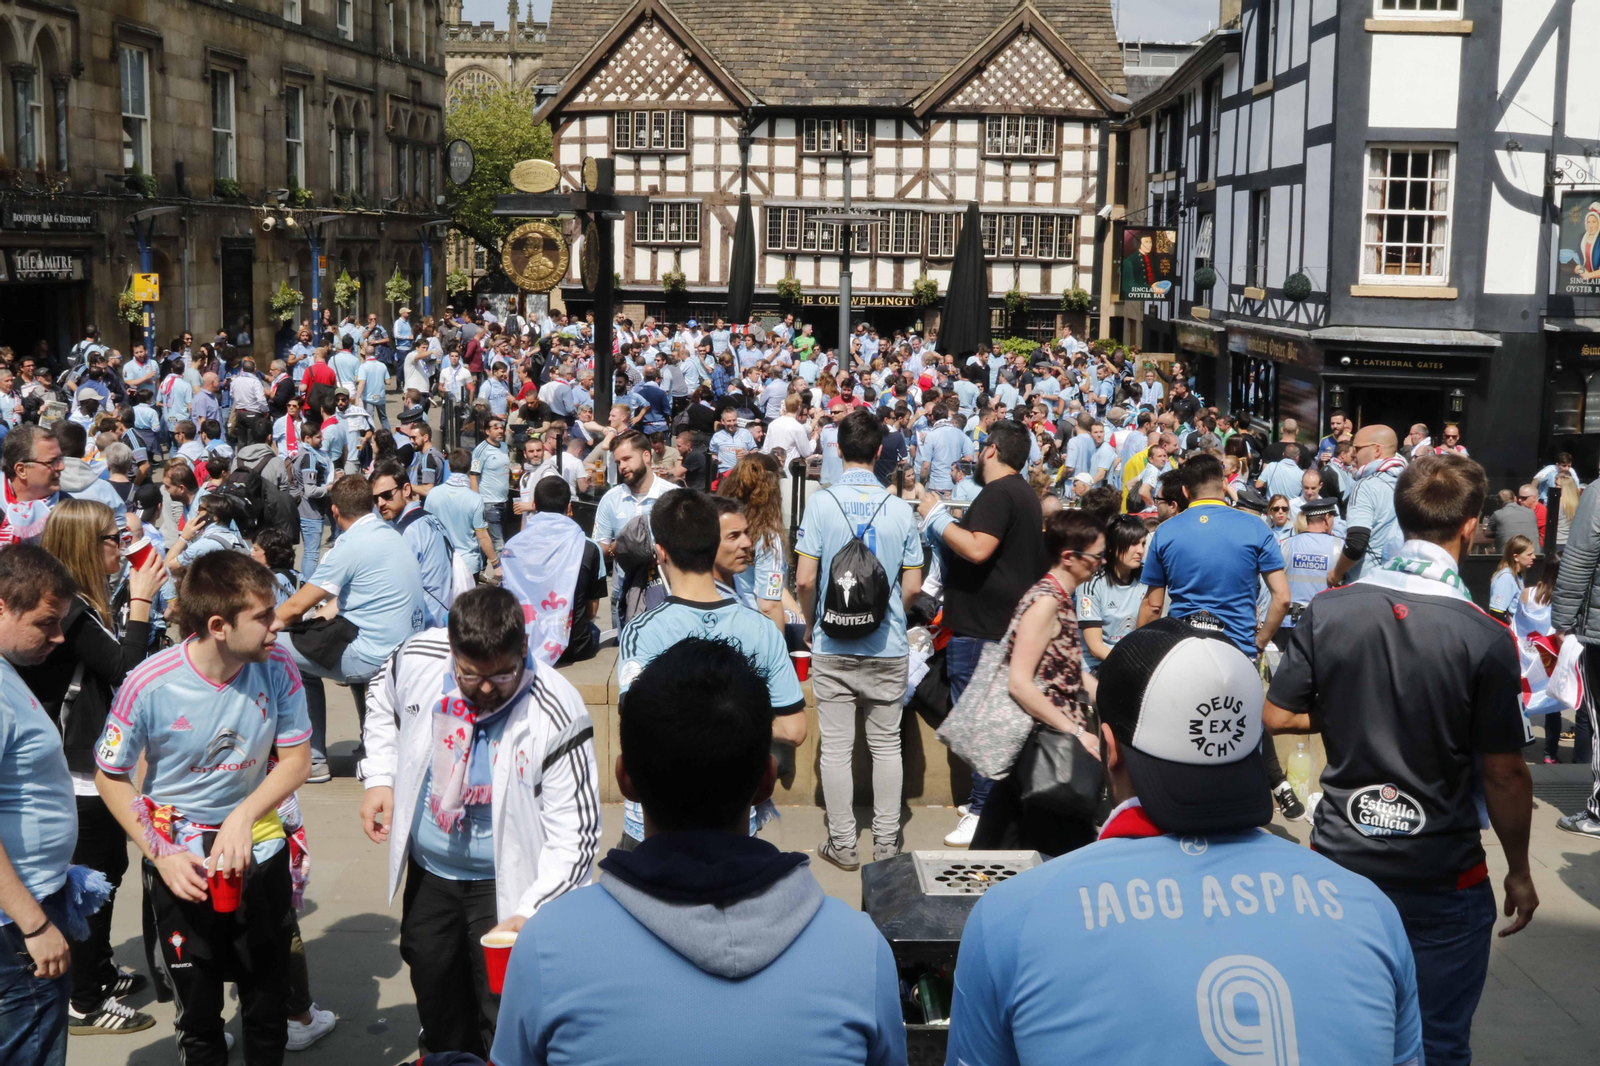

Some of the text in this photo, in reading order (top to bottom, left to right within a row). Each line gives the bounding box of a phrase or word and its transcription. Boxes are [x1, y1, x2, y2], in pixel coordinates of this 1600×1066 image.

[523, 224, 545, 232] THE
[15, 254, 73, 269] THE MITRE
[502, 255, 515, 276] OLD
[514, 255, 569, 291] WELLINGTON
[1565, 285, 1593, 294] OYSTER
[1363, 359, 1413, 368] CATHEDRAL
[1416, 361, 1444, 370] GATES
[1294, 561, 1326, 570] LIAISON
[1296, 554, 1326, 563] POLICE
[767, 587, 780, 597] LFP
[823, 611, 875, 626] AFOUTEZA
[1190, 620, 1218, 630] Galicia
[1195, 695, 1244, 718] DEUS
[1209, 719, 1233, 734] EX
[1188, 714, 1247, 758] MACHINA
[1358, 794, 1416, 820] Estrella
[1359, 809, 1410, 832] Galicia
[1079, 871, 1344, 931] IAGO ASPAS
[1196, 954, 1300, 1066] 9
